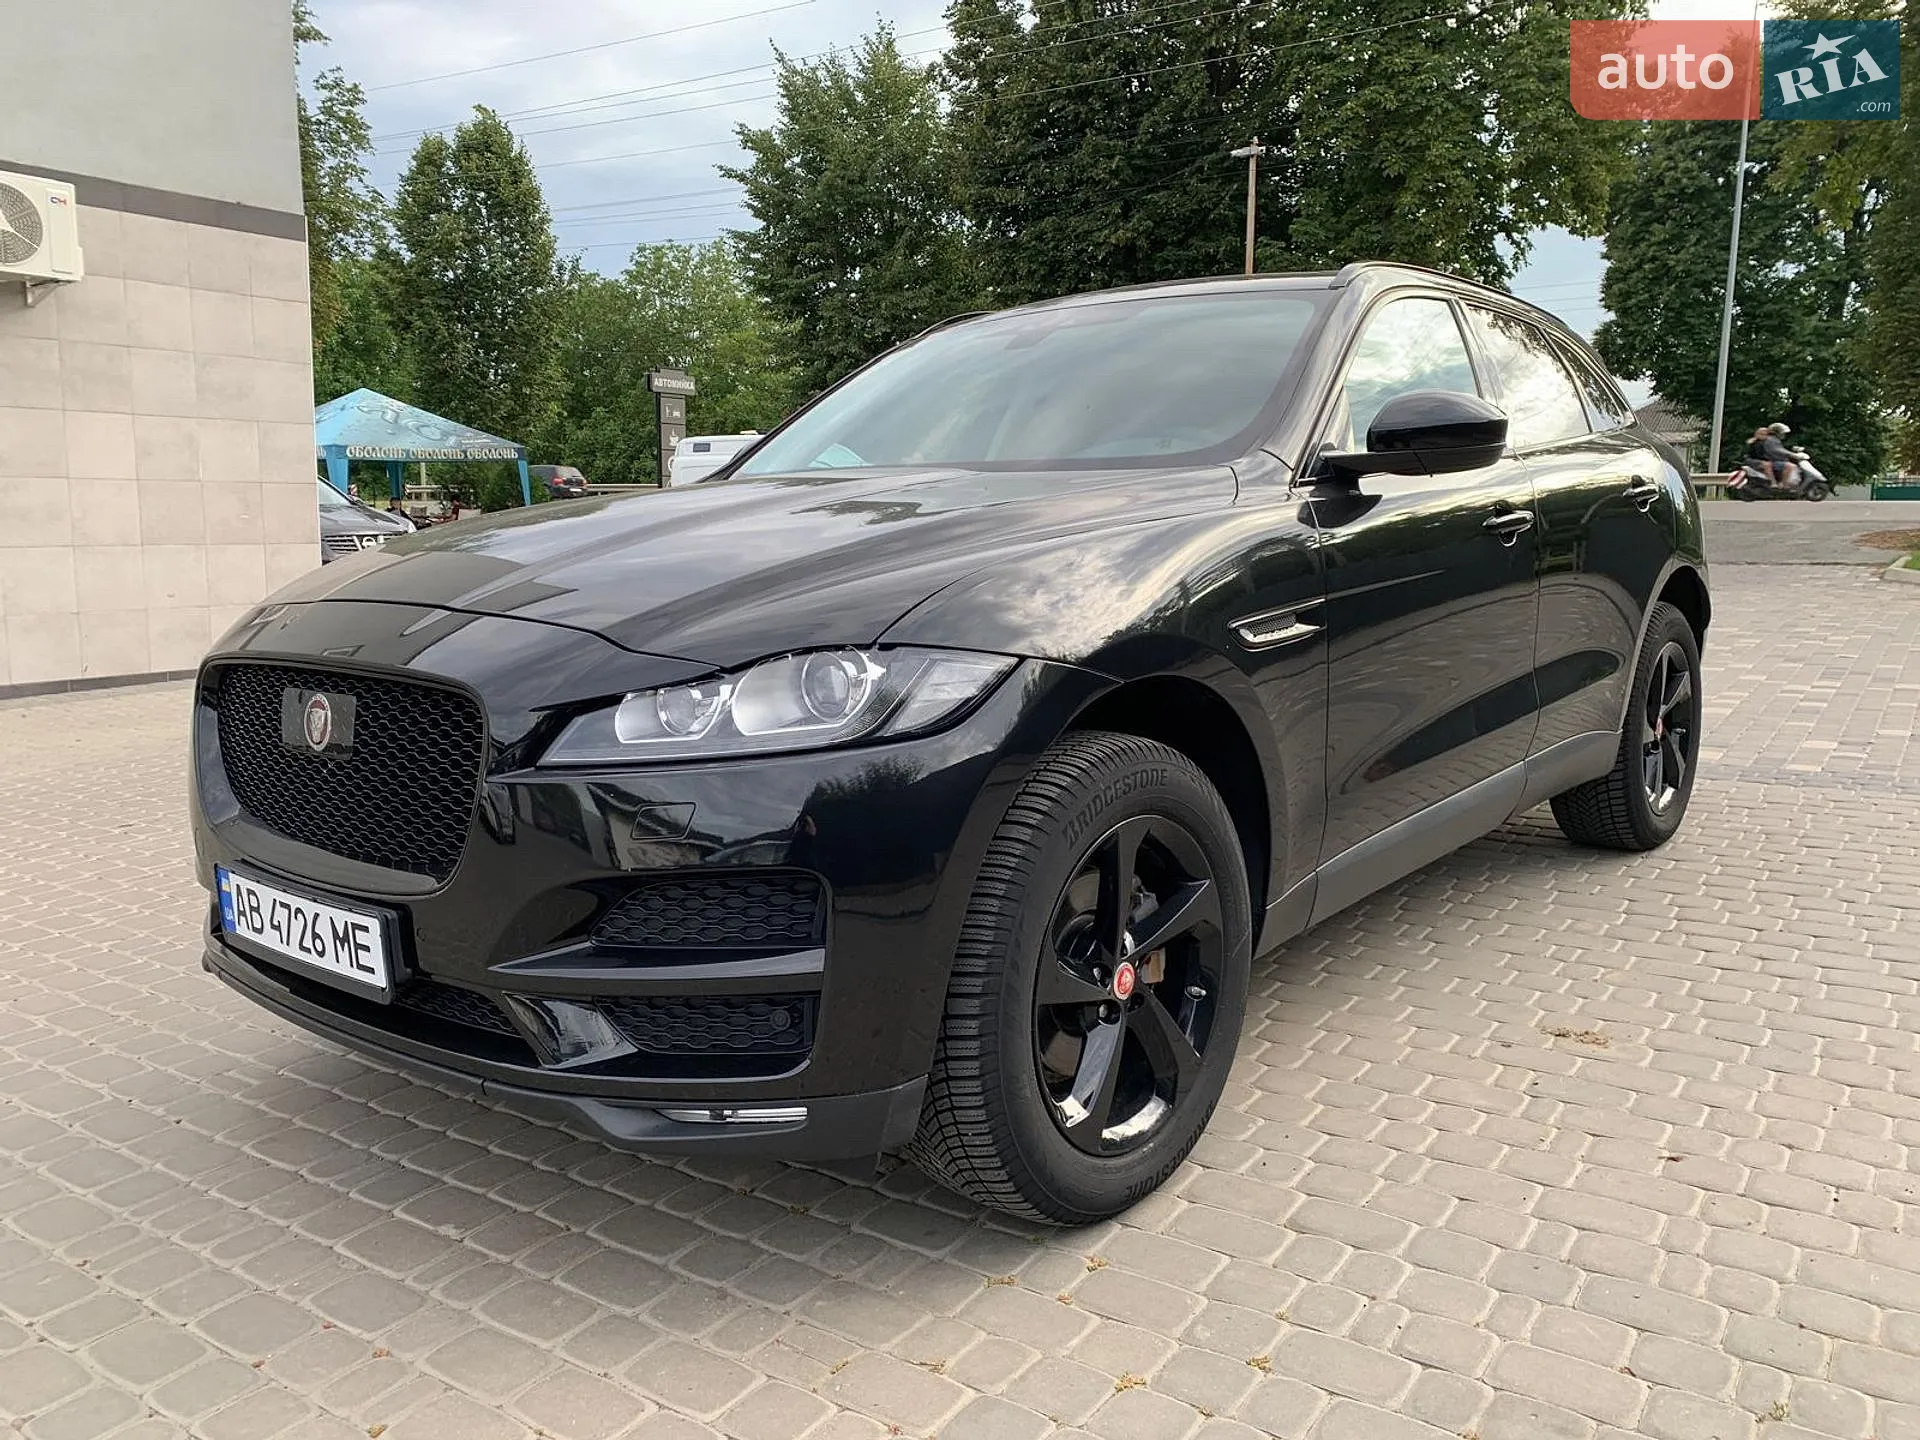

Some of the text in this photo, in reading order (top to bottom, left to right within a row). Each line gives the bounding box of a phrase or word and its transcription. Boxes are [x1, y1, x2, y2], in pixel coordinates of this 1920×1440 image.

[346, 446, 518, 459] ОБОЛОНЬ ОБОЛОНЬ ОБОЛОНЬ
[1062, 768, 1168, 849] BRIDGESTONE
[236, 883, 376, 975] AB 4726 ME
